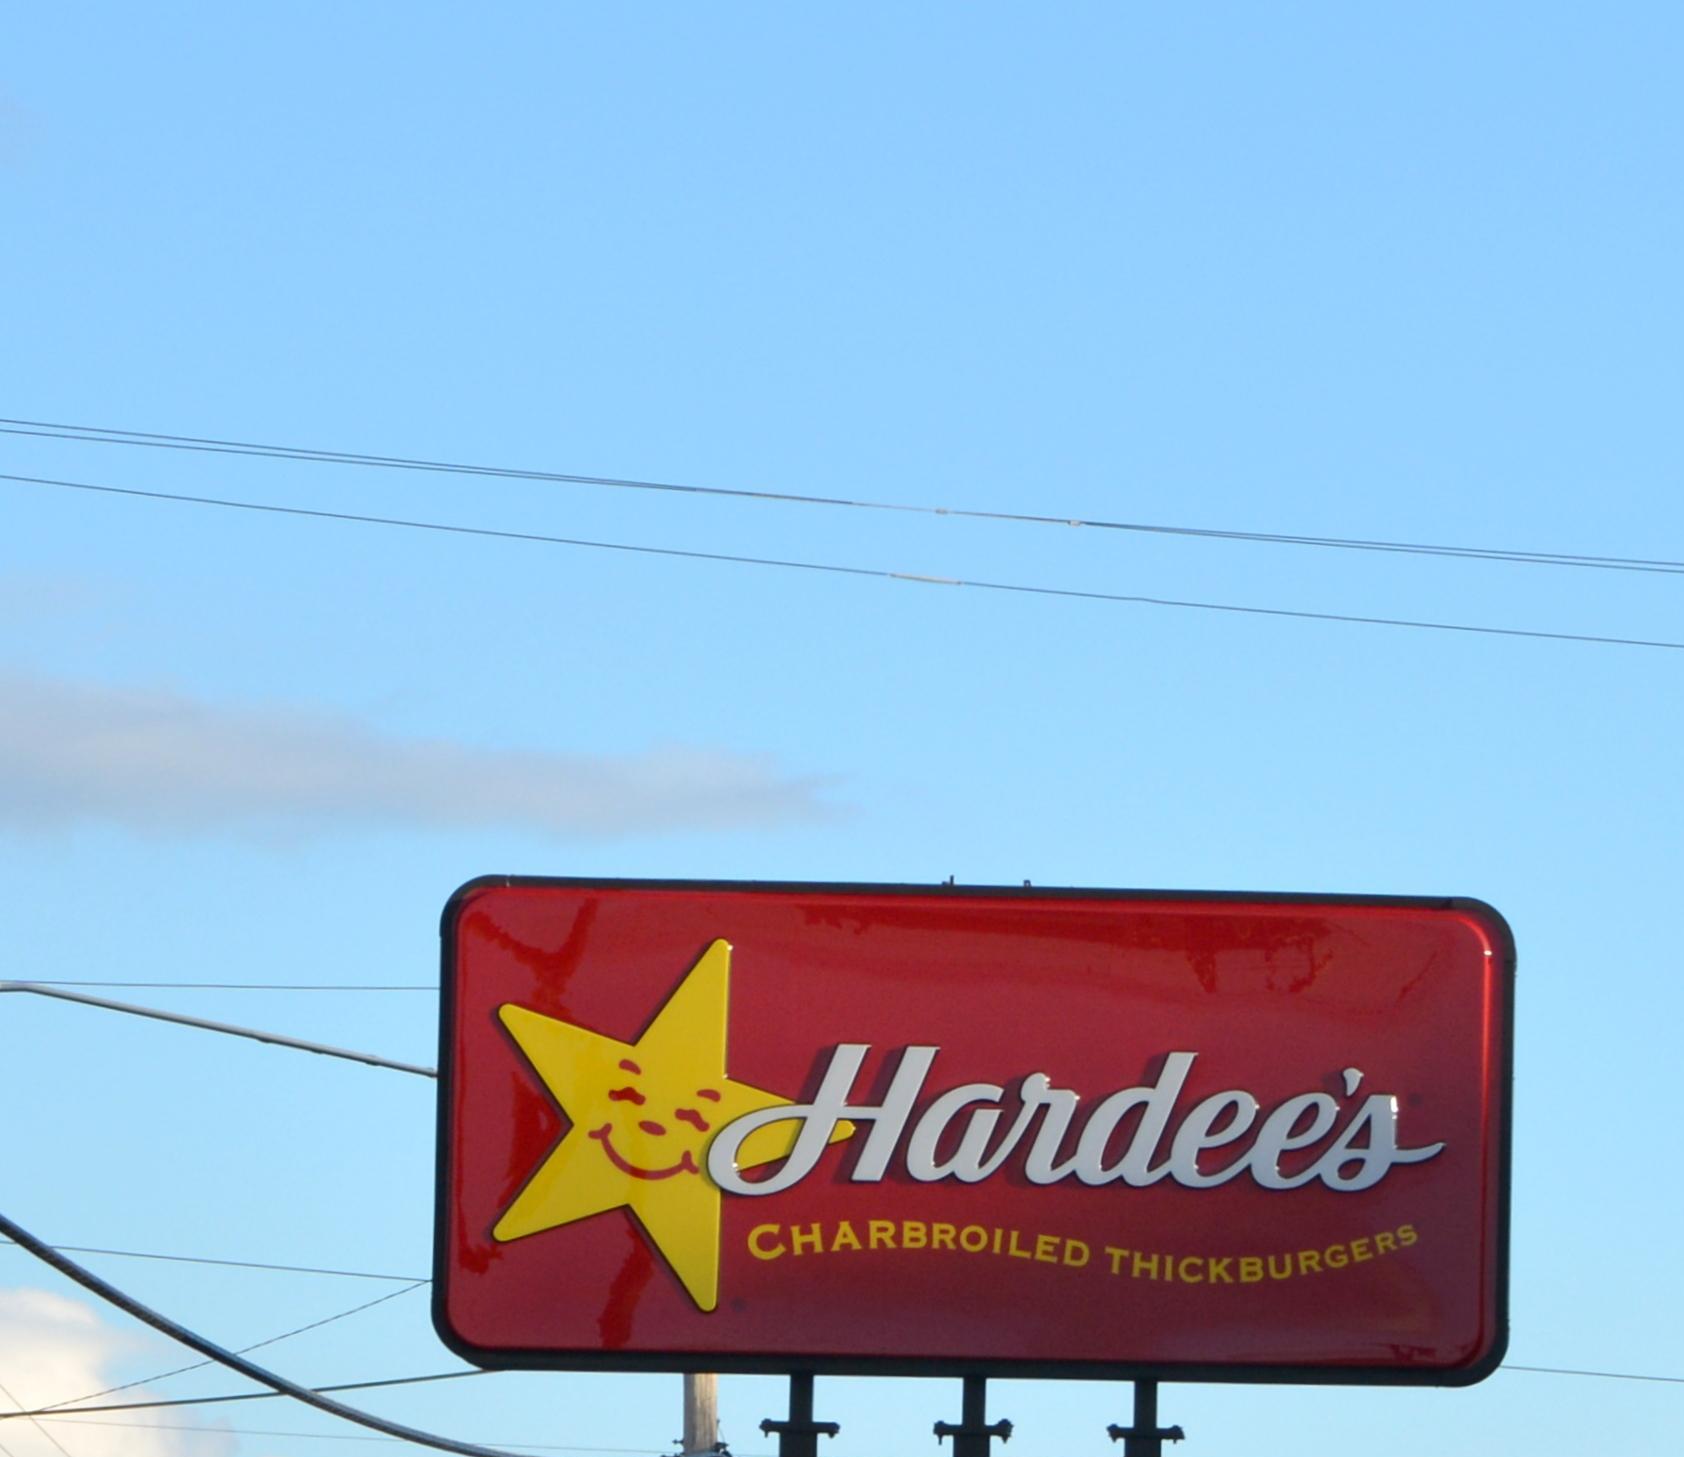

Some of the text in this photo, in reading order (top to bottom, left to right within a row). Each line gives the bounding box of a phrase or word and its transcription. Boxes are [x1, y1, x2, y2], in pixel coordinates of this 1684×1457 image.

[707, 1043, 1446, 1196] Hardee's
[746, 1219, 1419, 1285] CHARBROILED THICKBURGERS
